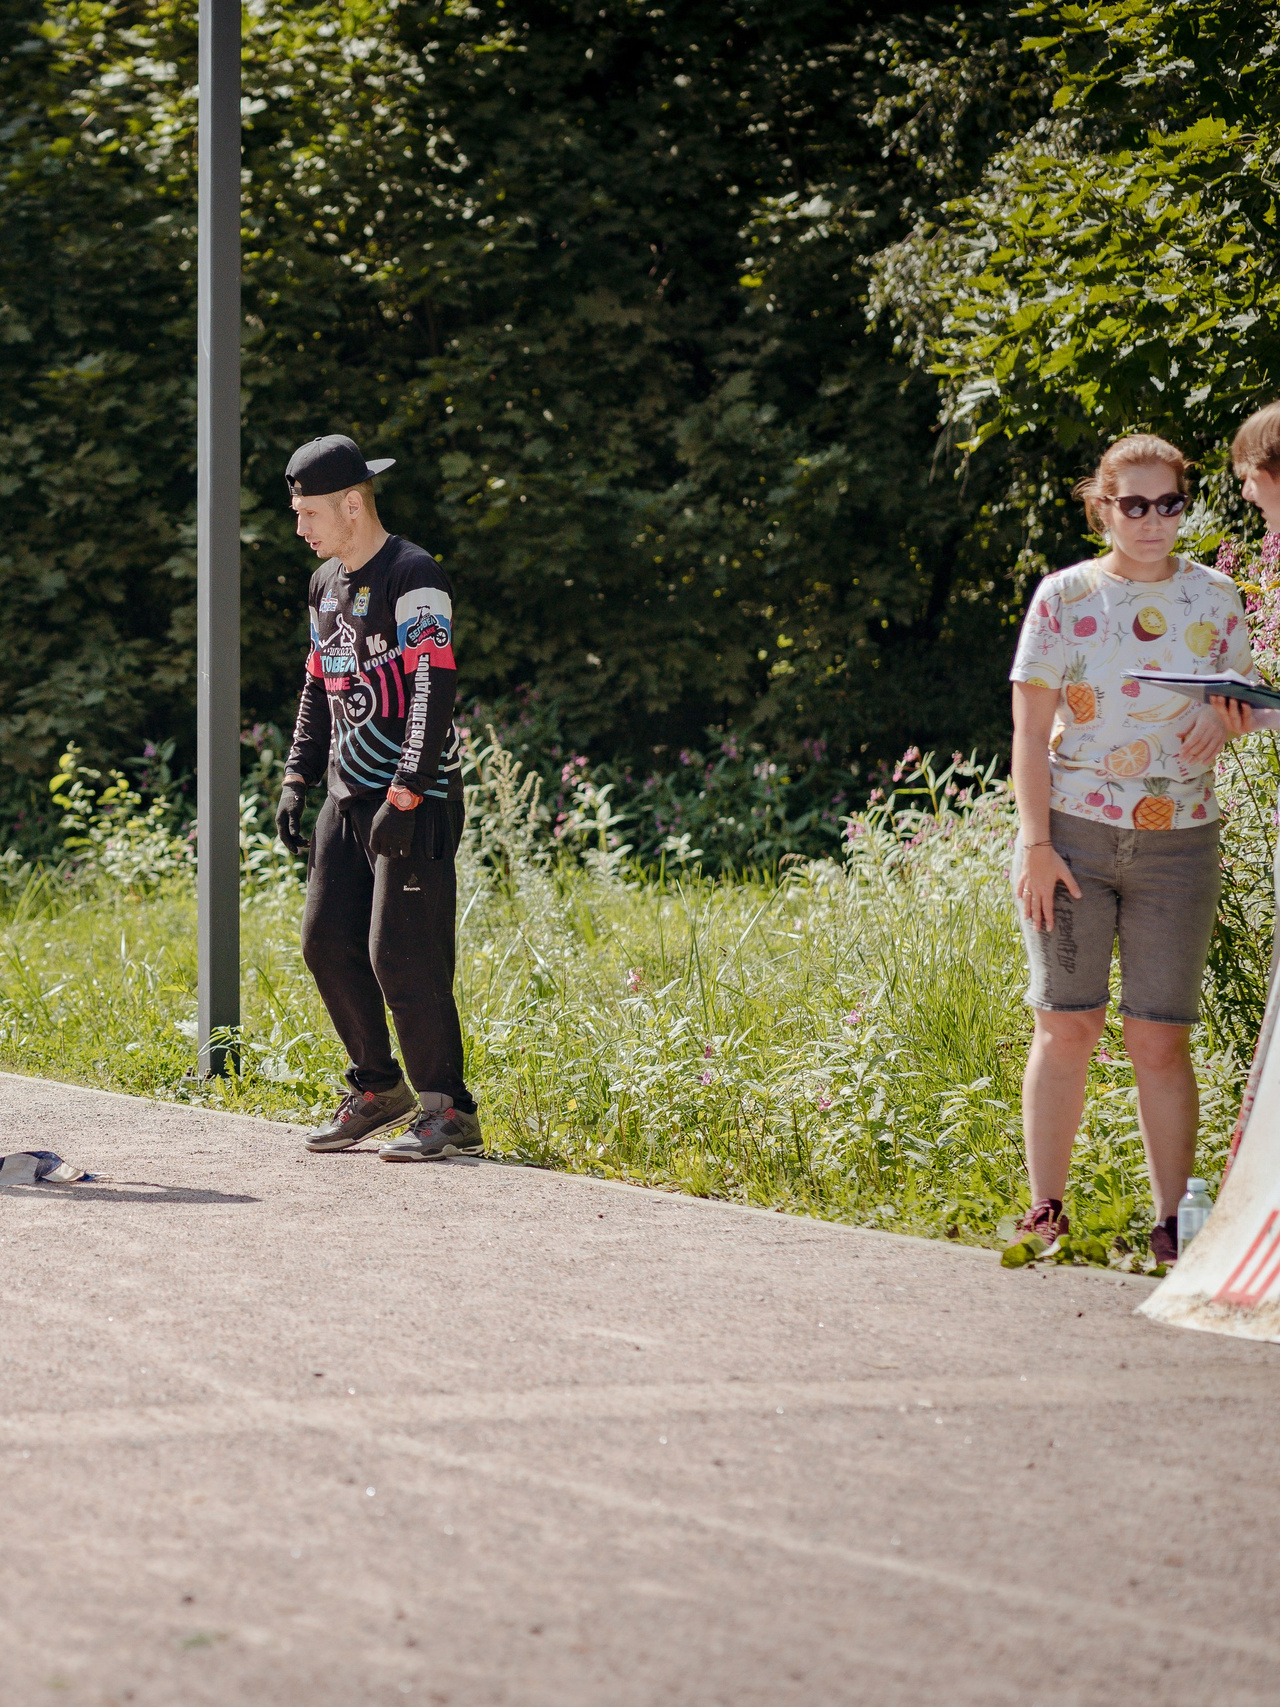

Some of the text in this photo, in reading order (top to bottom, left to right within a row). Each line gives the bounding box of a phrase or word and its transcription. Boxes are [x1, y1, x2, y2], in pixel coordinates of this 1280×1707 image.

[365, 633, 388, 656] 16
[363, 645, 402, 672] VOITOV
[404, 654, 432, 773] БЕГОВЕЛВИДНОЕ
